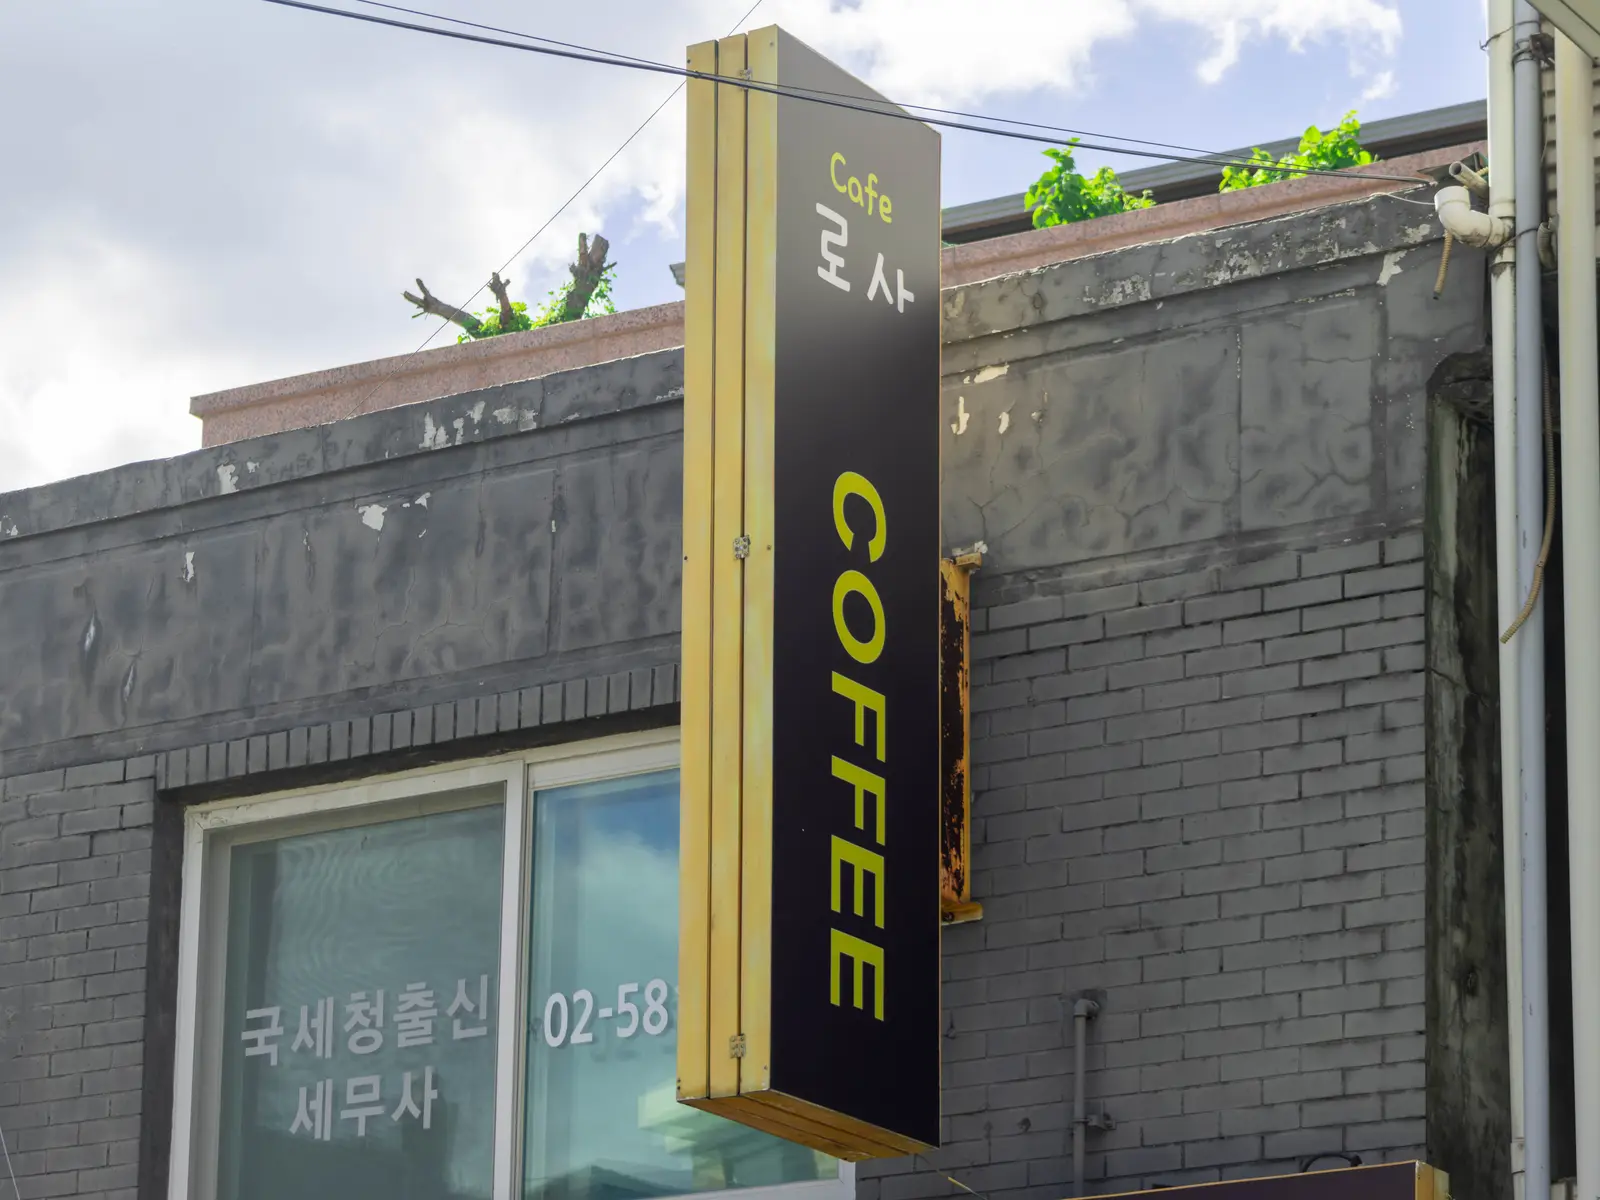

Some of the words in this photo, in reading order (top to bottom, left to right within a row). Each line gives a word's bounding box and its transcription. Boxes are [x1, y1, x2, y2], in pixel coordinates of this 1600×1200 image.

[830, 152, 893, 224] Cafe
[815, 202, 915, 313] 로사
[830, 471, 887, 1021] COFFEE
[240, 973, 489, 1067] 국세청출신
[543, 978, 679, 1048] 02-58
[288, 1065, 439, 1142] 세무사
